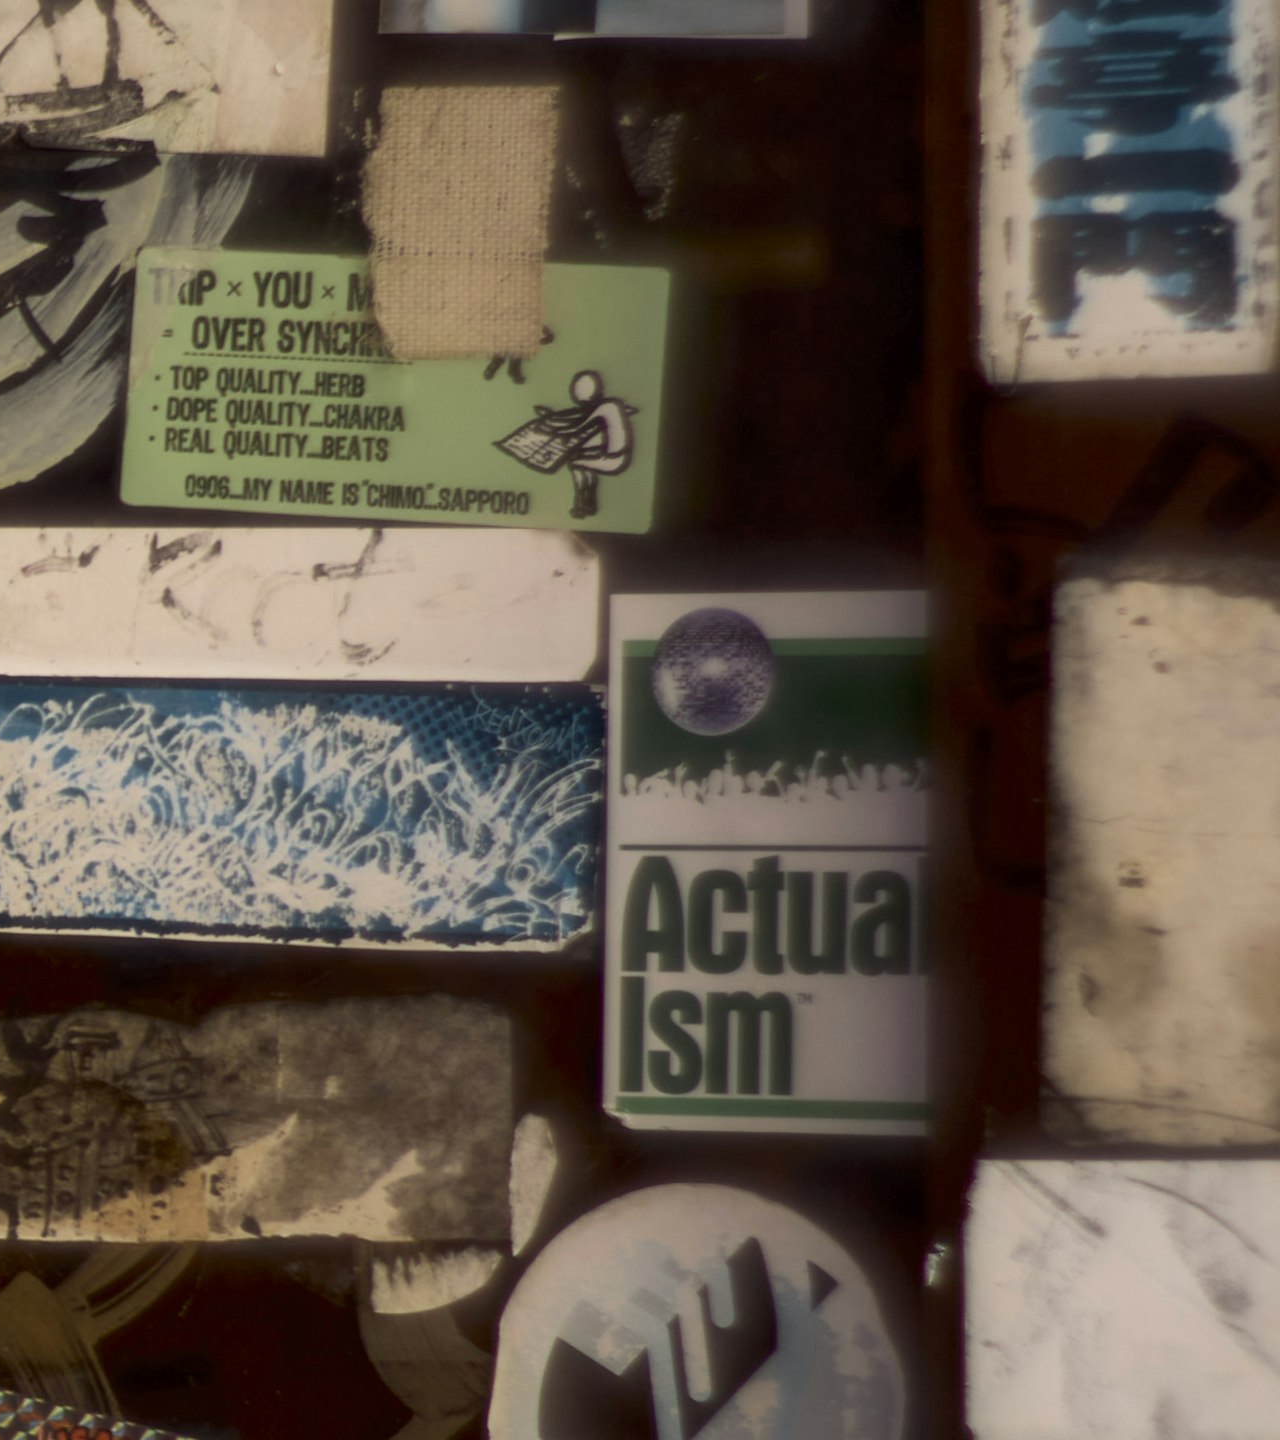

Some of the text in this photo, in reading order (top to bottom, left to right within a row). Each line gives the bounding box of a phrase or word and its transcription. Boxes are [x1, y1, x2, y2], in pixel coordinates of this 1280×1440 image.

[252, 270, 314, 309] YOU
[346, 274, 374, 312] M
[190, 316, 267, 352] OVER
[169, 365, 208, 390] TOP
[165, 397, 218, 424] DOPE
[163, 427, 215, 455] REAL
[278, 478, 334, 506] NAME
[341, 481, 358, 505] IS
[618, 975, 793, 1096] Ism
